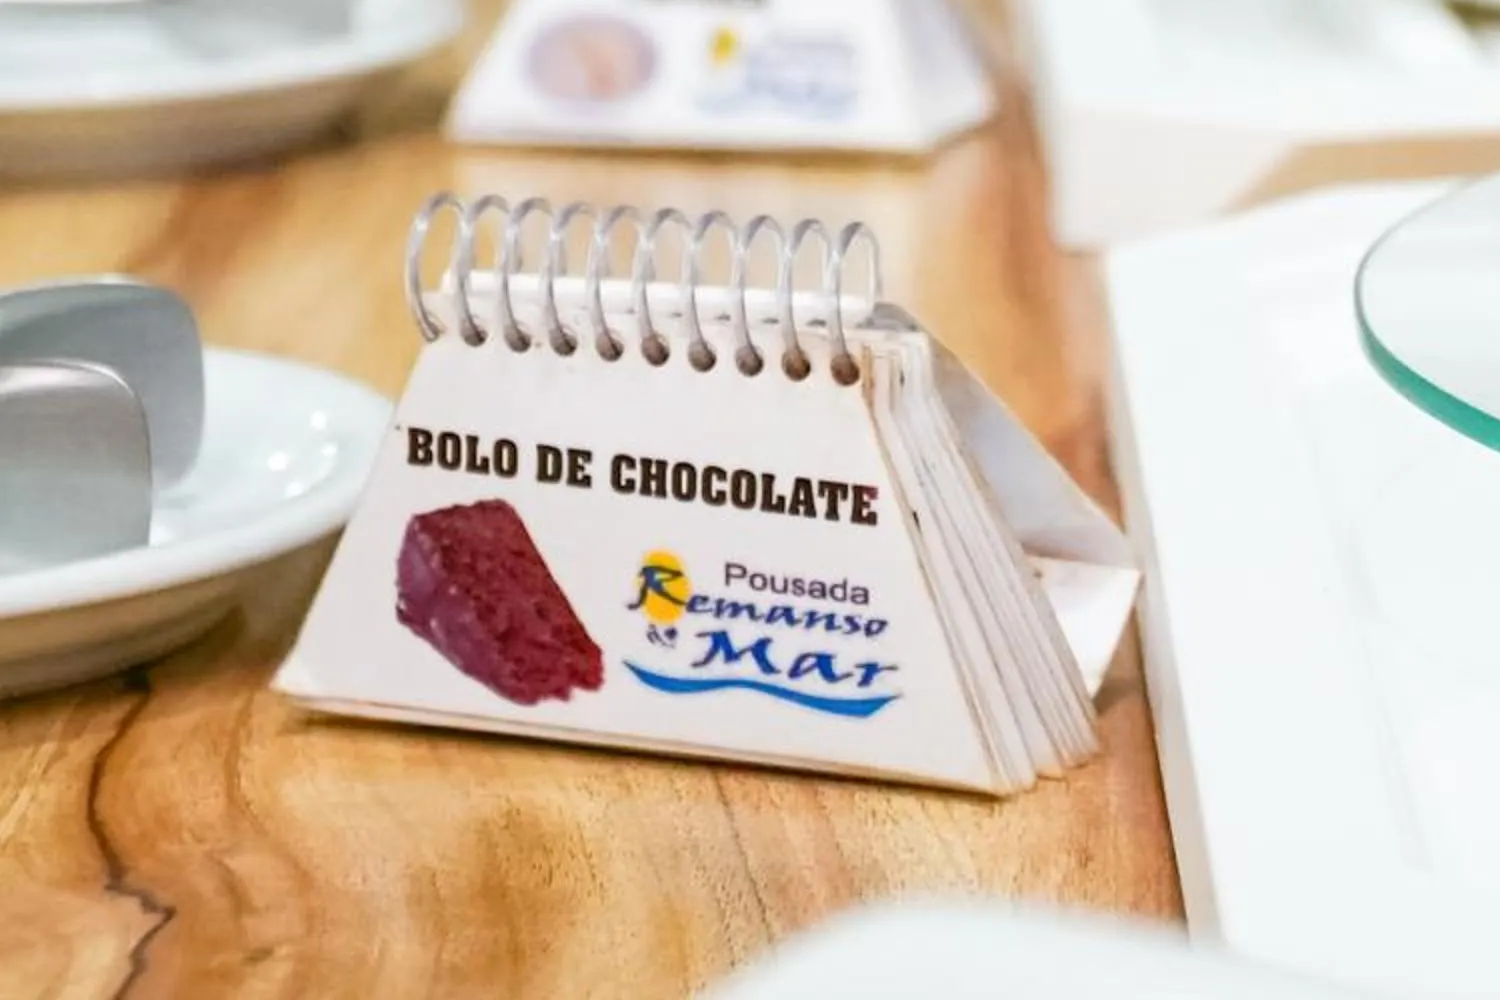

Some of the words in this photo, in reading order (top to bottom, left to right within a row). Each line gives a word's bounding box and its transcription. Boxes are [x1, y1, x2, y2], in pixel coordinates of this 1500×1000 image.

[406, 425, 520, 479] BOLO
[535, 443, 594, 489] DE
[609, 453, 880, 527] CHOCOLATE
[626, 564, 889, 638] Remanso
[723, 561, 871, 606] Pousada
[689, 629, 899, 688] Mar
